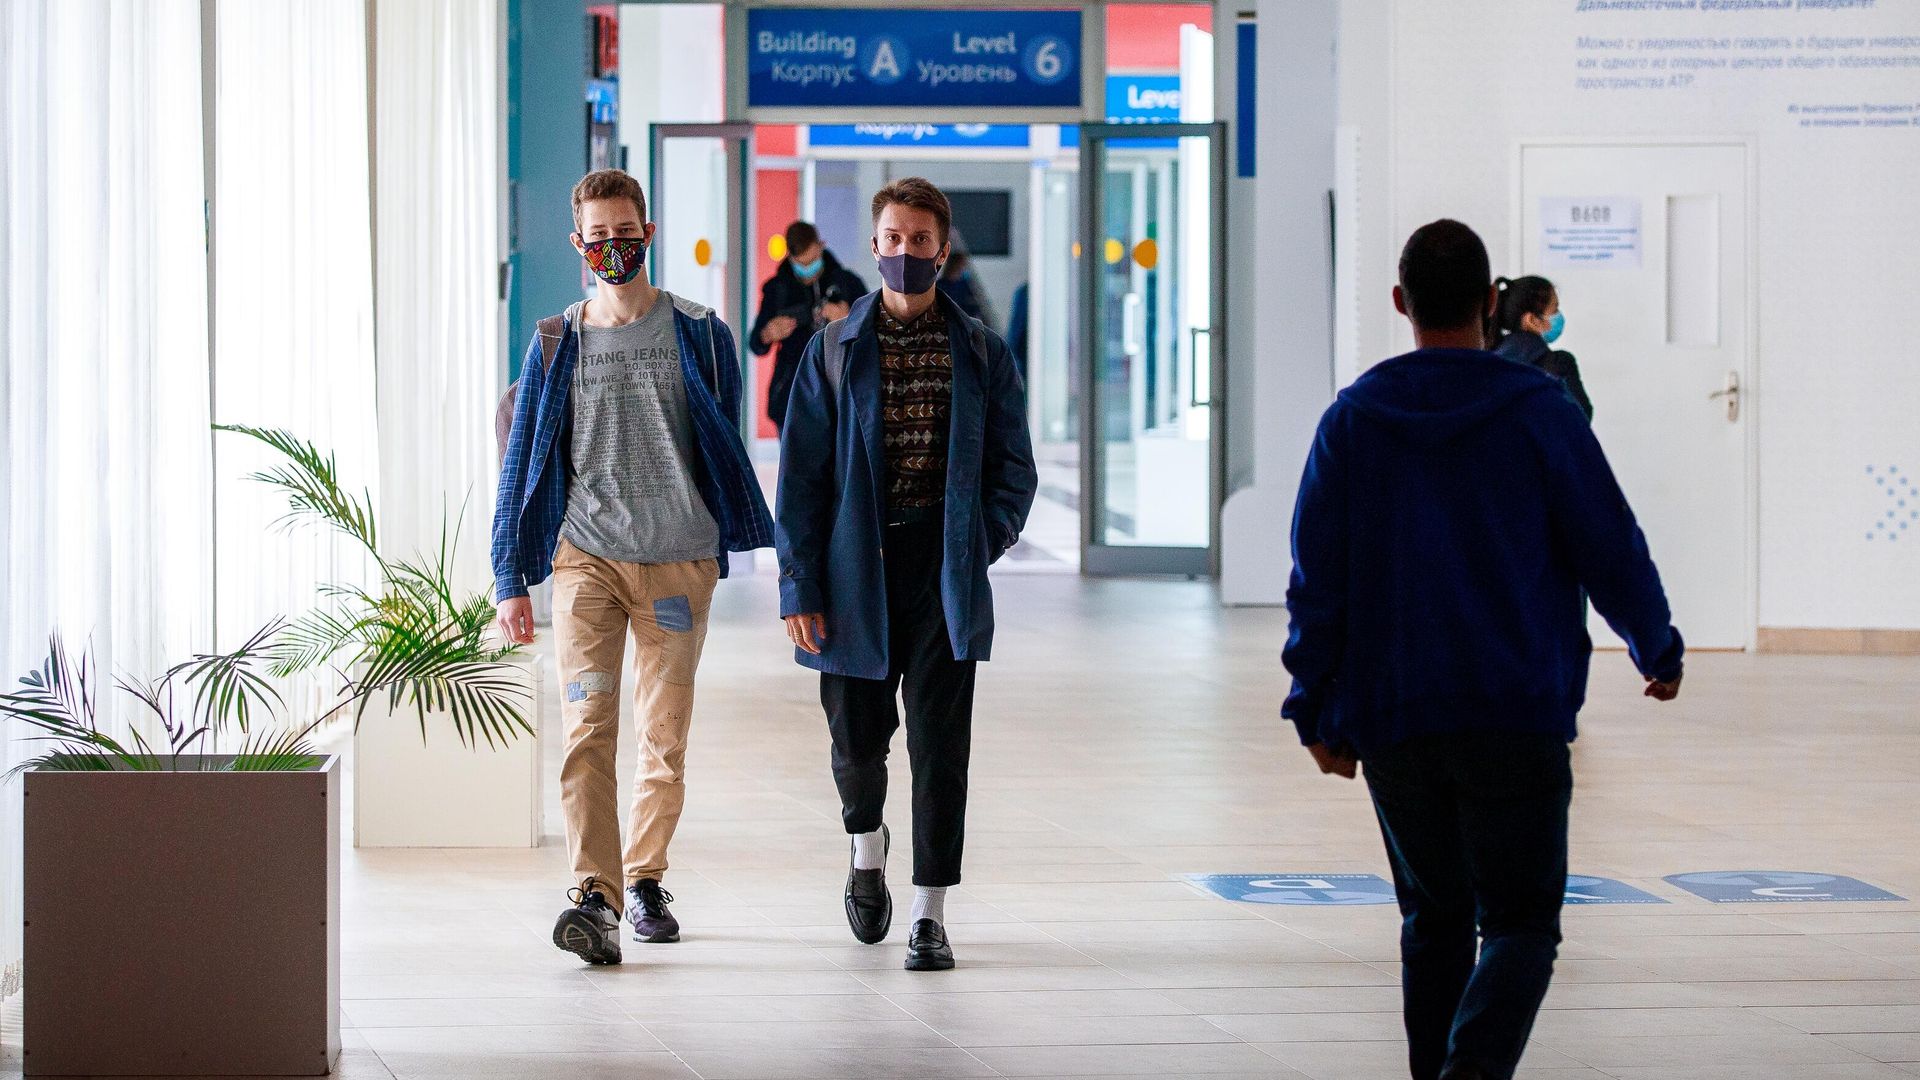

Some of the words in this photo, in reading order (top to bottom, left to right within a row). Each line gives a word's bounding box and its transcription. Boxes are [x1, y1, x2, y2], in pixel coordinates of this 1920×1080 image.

[757, 31, 856, 58] Building
[953, 32, 1017, 54] Level
[1034, 41, 1061, 78] 6
[771, 60, 856, 88] Корпус
[915, 60, 1018, 88] Уровень
[1127, 84, 1180, 109] Leve
[577, 350, 626, 368] STANG
[631, 348, 679, 361] JEANS
[624, 362, 641, 371] P.O.
[645, 361, 663, 370] BOX
[666, 362, 678, 371] 32
[621, 382, 646, 391] TOWN
[624, 372, 635, 381] AT
[639, 371, 660, 380] 10TH
[664, 372, 676, 381] ST.
